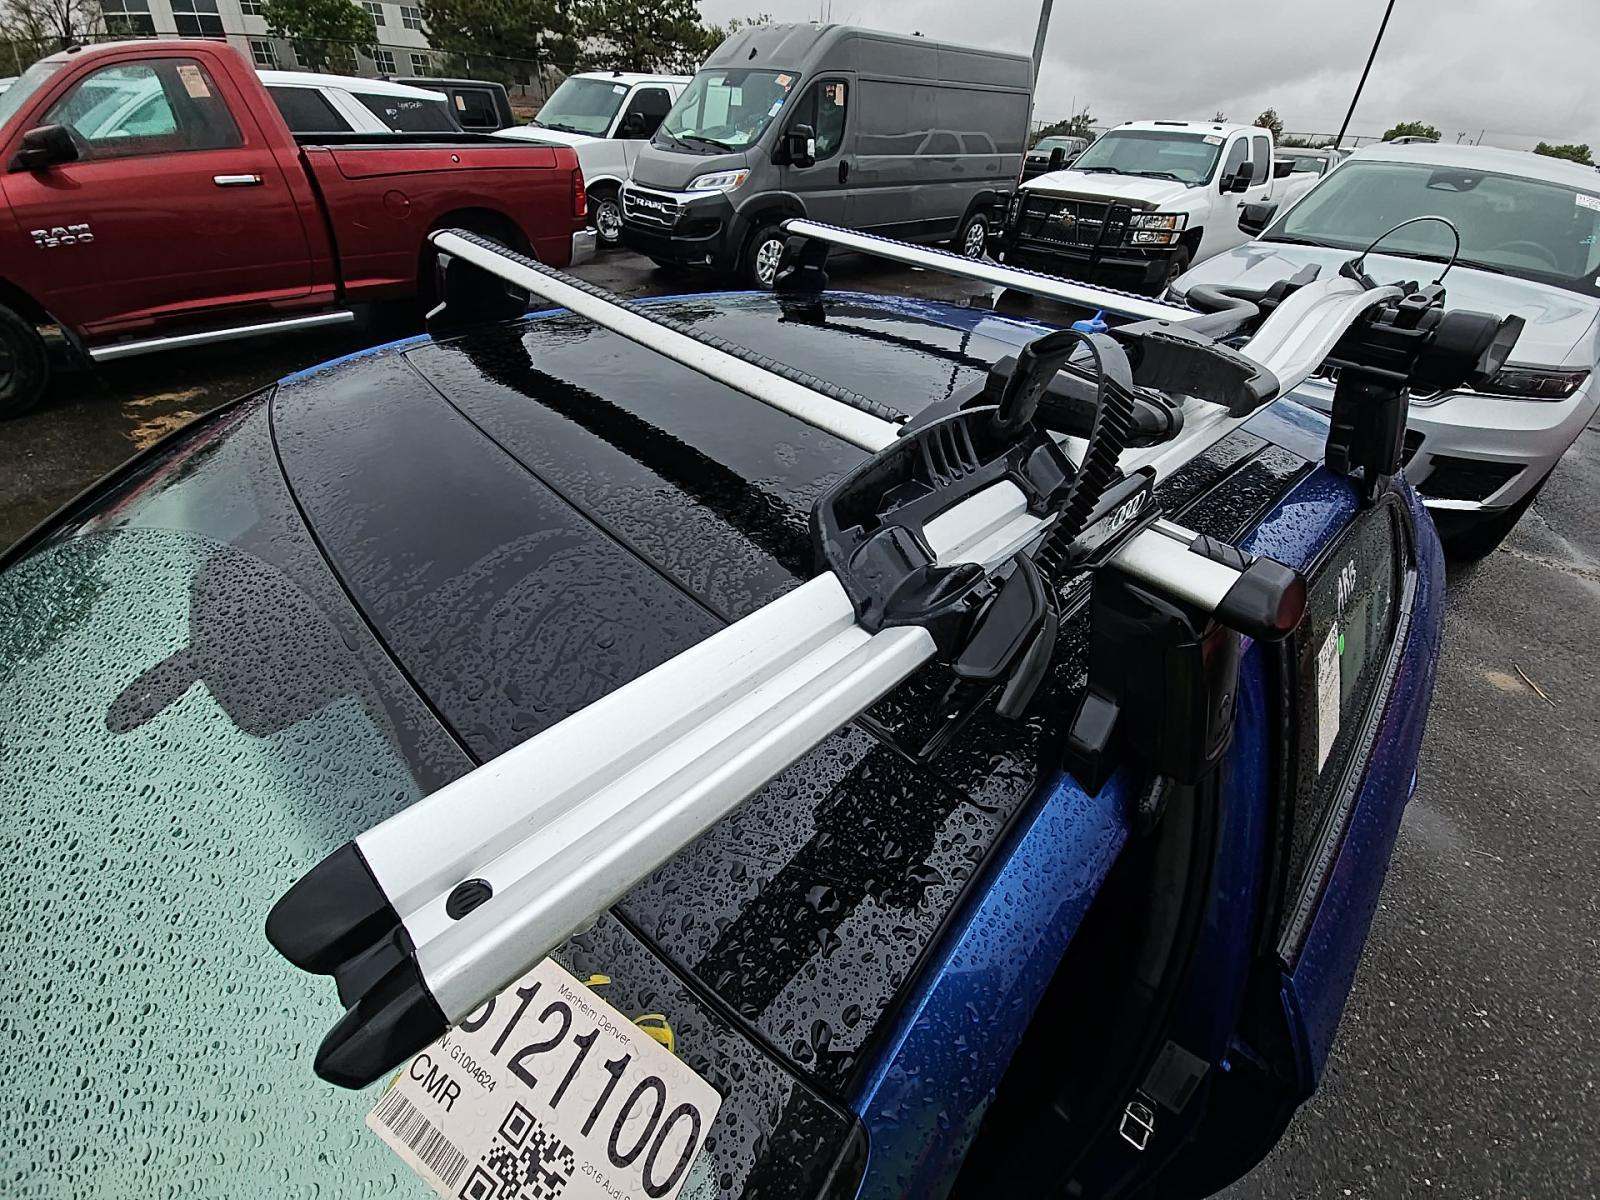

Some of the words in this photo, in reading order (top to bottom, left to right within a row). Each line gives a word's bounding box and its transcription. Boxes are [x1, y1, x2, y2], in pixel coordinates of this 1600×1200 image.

[636, 198, 662, 210] RAM
[30, 223, 90, 238] RAM
[35, 233, 94, 249] 1500
[557, 983, 598, 1021] Manheim
[597, 1014, 631, 1046] Denver
[410, 1053, 461, 1113] CMR
[450, 1045, 497, 1093] G1004624
[581, 1161, 603, 1184] 2016
[601, 1179, 624, 1200] Audi
